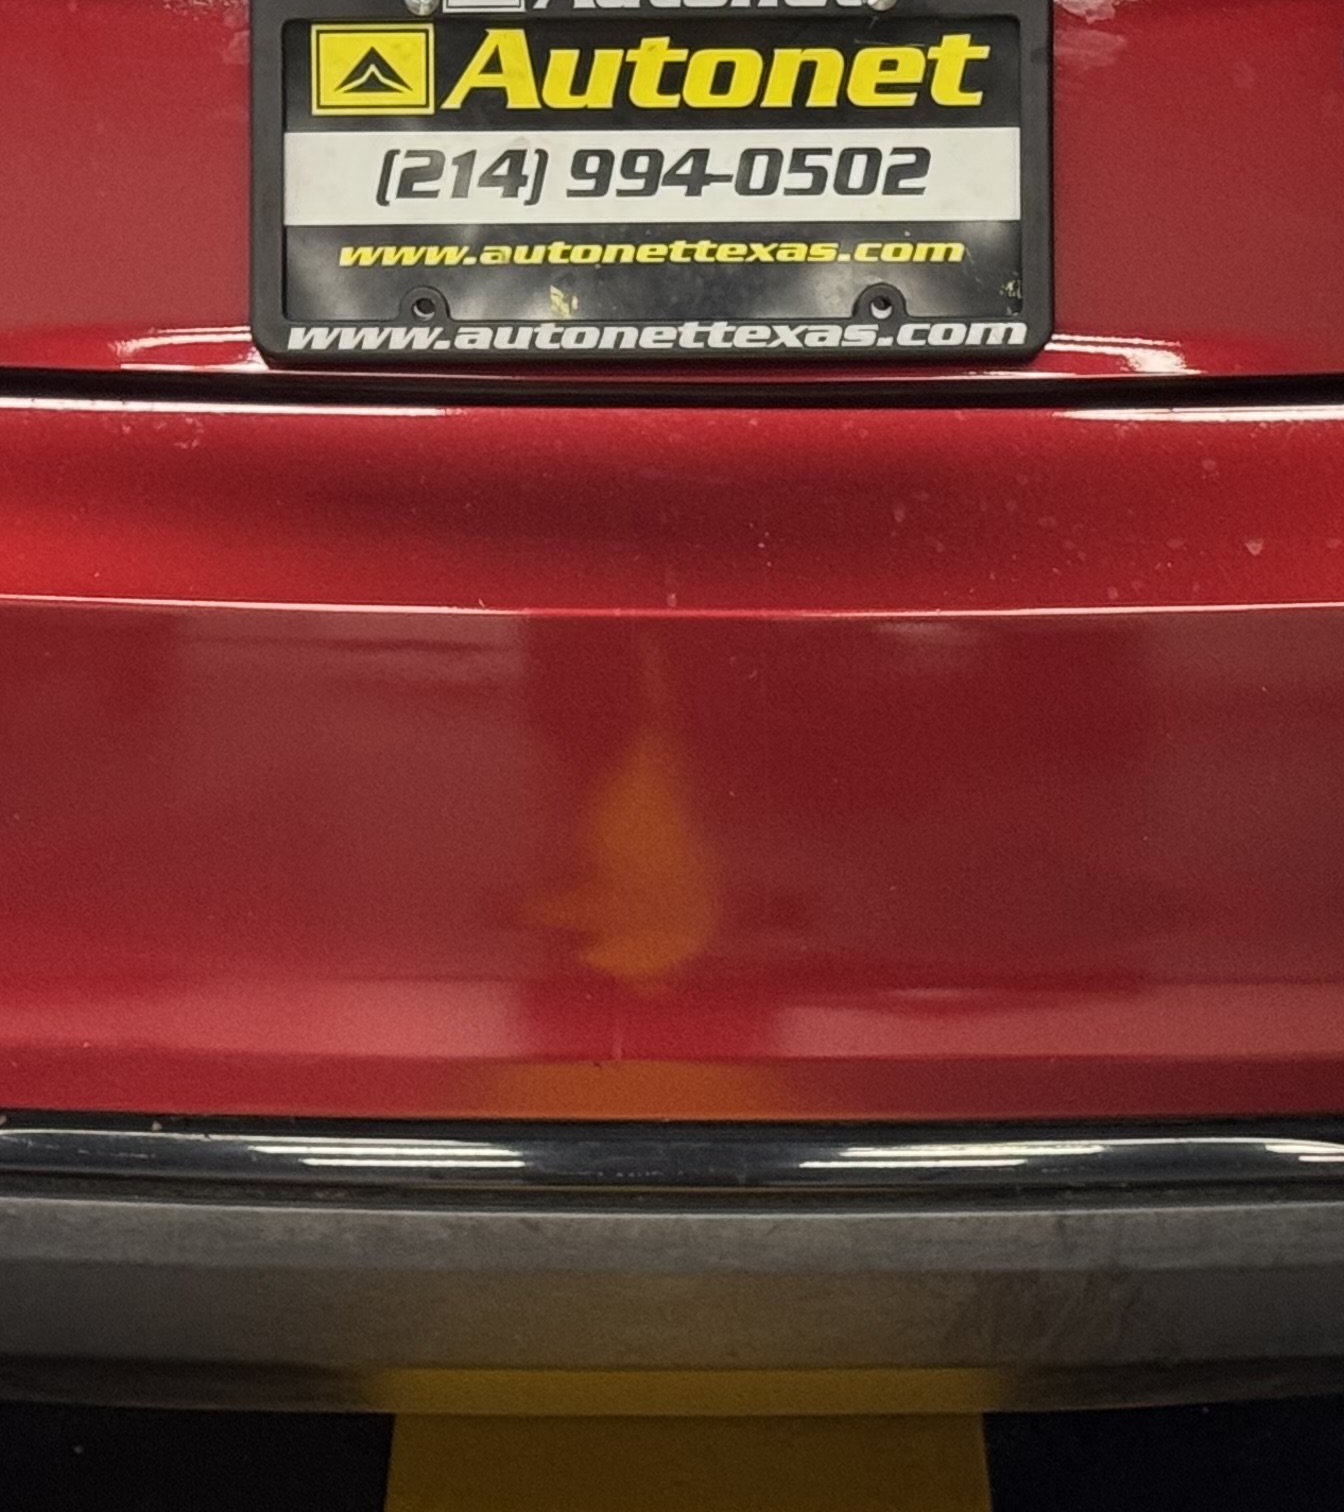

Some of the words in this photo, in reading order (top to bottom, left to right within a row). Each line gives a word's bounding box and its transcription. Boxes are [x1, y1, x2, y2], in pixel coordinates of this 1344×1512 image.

[443, 28, 991, 110] Autonet
[375, 147, 549, 207] (214)
[566, 146, 932, 198] 994-0502
[338, 237, 966, 267] www.autonettexas.com
[286, 318, 1029, 351] www.autonettexas.com
